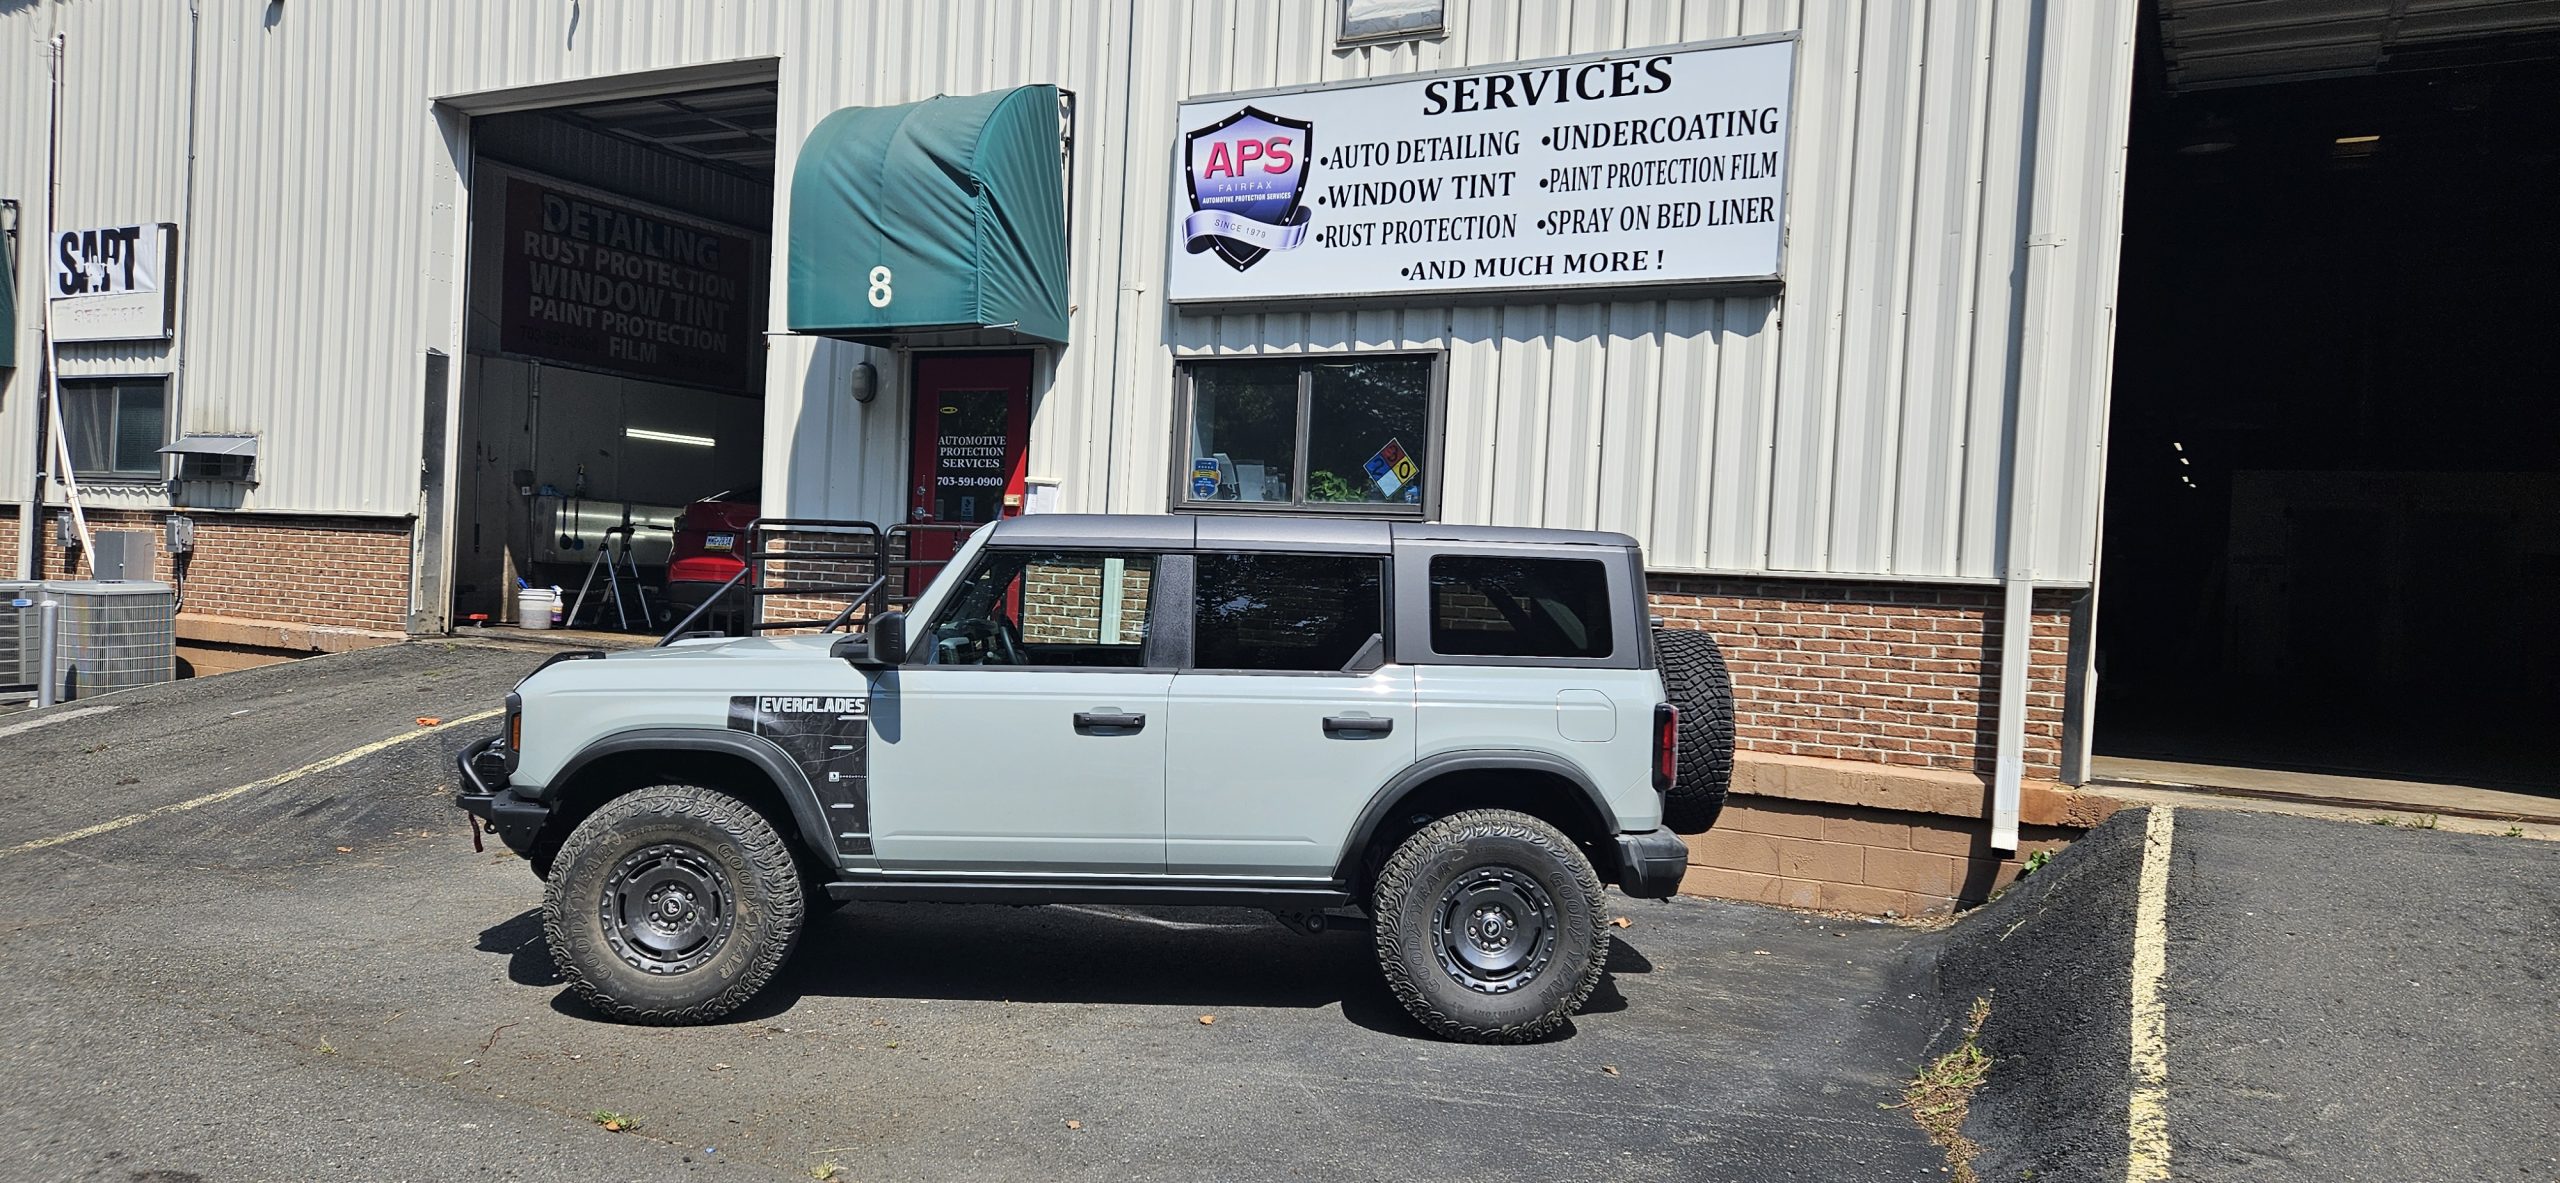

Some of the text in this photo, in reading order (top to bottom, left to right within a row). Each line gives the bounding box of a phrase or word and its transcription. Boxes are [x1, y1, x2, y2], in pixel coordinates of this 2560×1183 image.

[1423, 56, 1673, 116] SERVICES
[1552, 107, 1779, 152] UNDERCOATING
[1203, 136, 1294, 180] APS
[1329, 130, 1520, 170] AUTO DETAILING
[1218, 180, 1273, 193] FAIRFAX
[1327, 171, 1516, 208] WINDOW TINT
[1549, 151, 1779, 193] PAINT PROTECTION FILM
[1202, 191, 1292, 204] AUTOMOTIVE PROTECTION SERVICES
[542, 192, 720, 271] DETAILING
[1214, 218, 1267, 239] SINCE 1979
[1324, 213, 1518, 248] RUST PROTECTION
[1546, 196, 1775, 236] SPRAY ON BED LINER
[523, 229, 736, 301] RUST PROTECTION
[1409, 249, 1665, 281] AND MUCH MORE !
[528, 260, 730, 332] WINDOW TINT
[868, 265, 892, 308] 8
[529, 295, 727, 353] PAINT PROTECTION
[608, 335, 658, 364] FILM
[938, 436, 1007, 446] AUTOMOTIVE
[940, 447, 1005, 457] PROTECTION
[936, 476, 1004, 486] 703-591-0900
[942, 458, 1000, 468] SERVICES
[1372, 458, 1411, 479] 2 0
[761, 697, 866, 713] EVERGLADES
